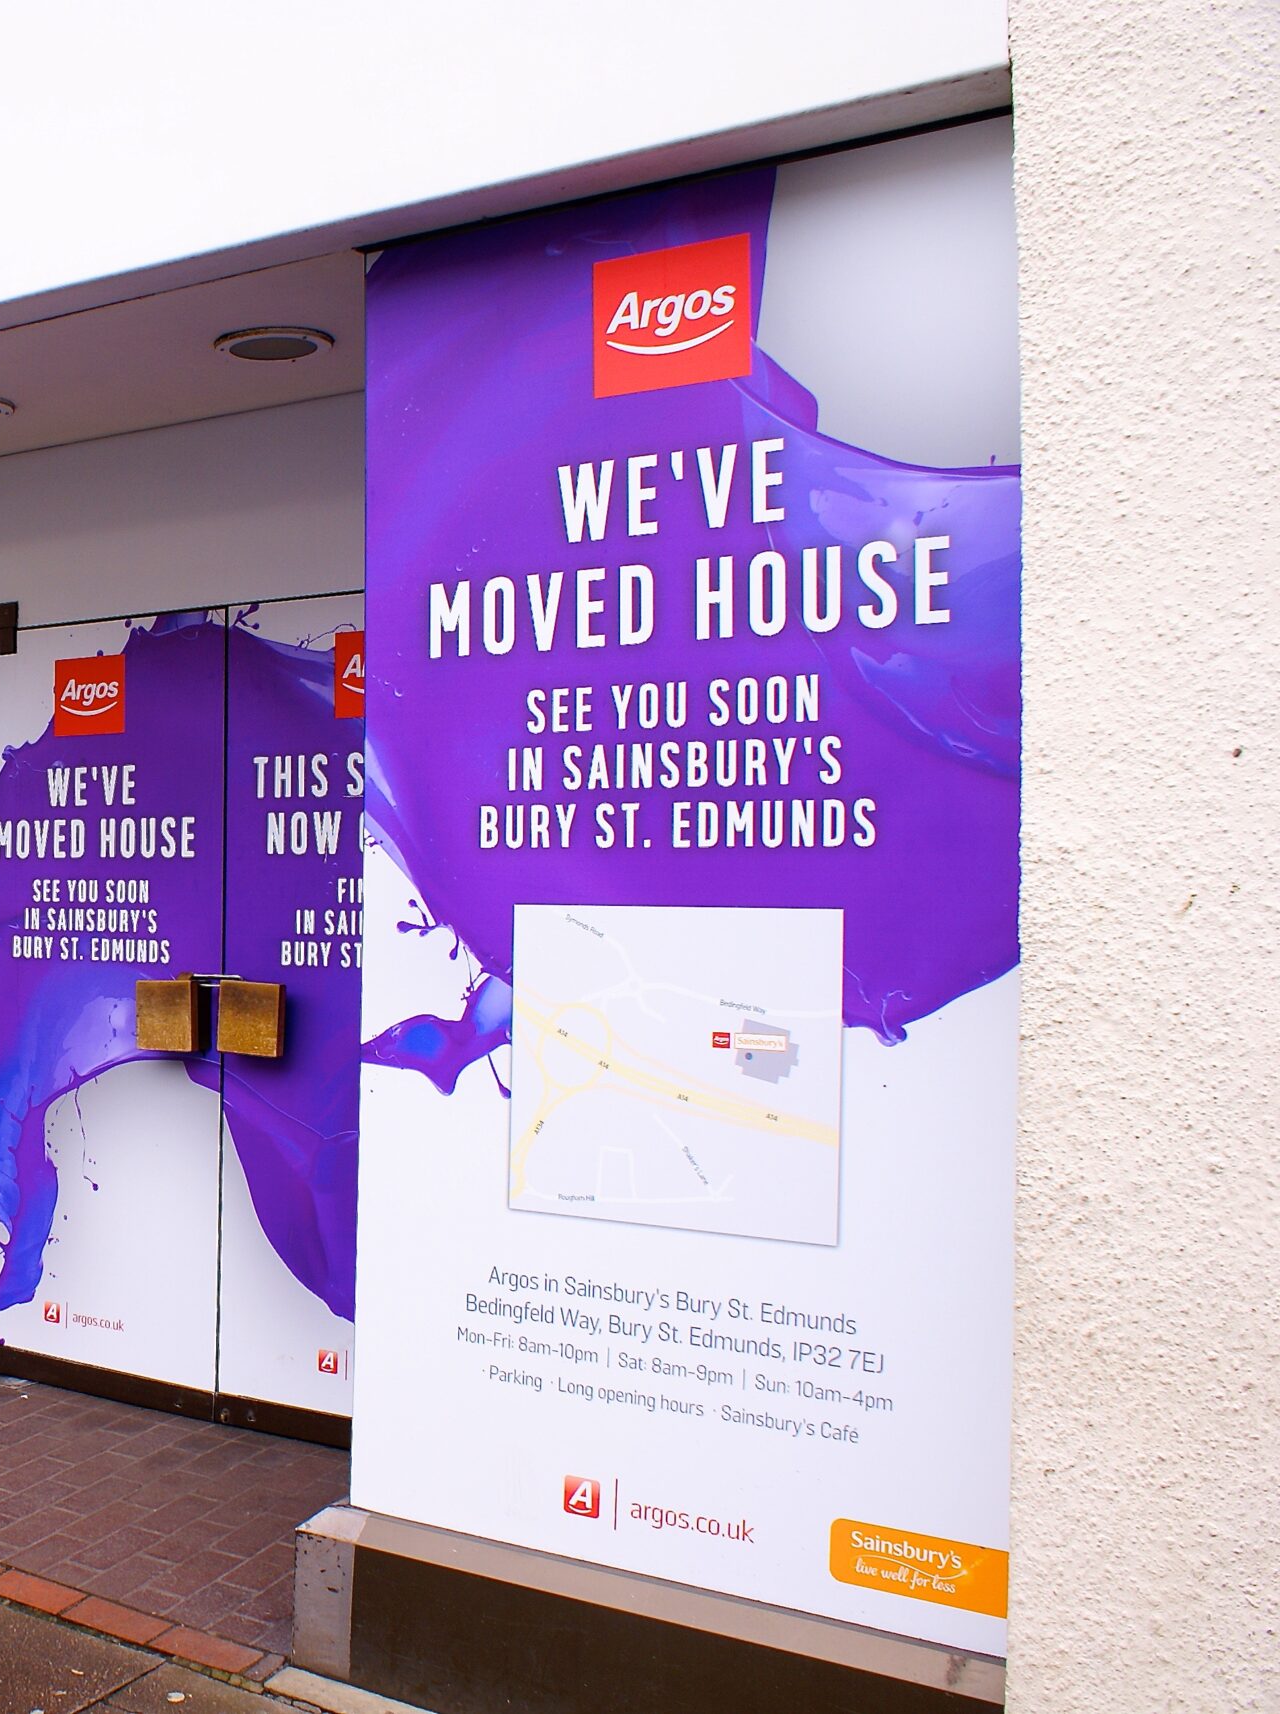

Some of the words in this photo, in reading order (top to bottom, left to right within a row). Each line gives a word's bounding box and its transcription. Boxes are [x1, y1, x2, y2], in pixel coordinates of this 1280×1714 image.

[607, 283, 736, 337] Argos
[556, 437, 785, 543] WE'VE
[429, 564, 654, 660] MOVED
[694, 534, 952, 642] HOUSE
[60, 678, 119, 706] Argos
[526, 686, 593, 734] SEE
[611, 680, 687, 731] YOU
[708, 673, 820, 728] SOON
[47, 764, 136, 807] WE'VE
[253, 754, 328, 799] THIS
[507, 747, 543, 792] IN
[562, 735, 843, 791] SAINSBURY'S
[100, 816, 195, 858] HOUSE
[266, 811, 342, 855] NOW
[479, 804, 576, 849] BURY
[594, 803, 652, 849] ST.
[672, 797, 877, 849] EDMUNDS
[32, 878, 60, 902] SEE
[67, 879, 99, 903] YOU
[105, 879, 149, 904] SOON
[24, 908, 40, 930] IN
[46, 907, 158, 934] SAINSBURY'S
[295, 909, 315, 935] IN
[12, 935, 53, 960] BURY
[60, 936, 84, 961] ST.
[90, 937, 170, 964] EDMUNDS
[280, 940, 331, 967] BURY
[72, 1311, 125, 1333] argos.co.uk
[488, 1265, 539, 1293] Argos
[544, 1272, 559, 1294] in
[564, 1276, 670, 1311] Sainsbury's
[676, 1291, 722, 1321] Bury
[727, 1297, 753, 1321] St.
[760, 1302, 857, 1336] Edmunds
[465, 1293, 554, 1325] Bedingfeld
[559, 1307, 603, 1337] Way,
[608, 1314, 653, 1344] Bury
[657, 1321, 683, 1345] St.
[689, 1325, 786, 1364] Edmunds,
[792, 1341, 842, 1369] IP32
[847, 1348, 885, 1375] 7EJ
[456, 1326, 515, 1350] Mon-Fri:
[517, 1335, 599, 1364] 8am-10pm
[618, 1351, 647, 1372] Sat:
[651, 1357, 733, 1388] 8am-9pm
[754, 1373, 790, 1395] Sun:
[795, 1379, 894, 1413] 10am-4pm
[489, 1364, 543, 1393] Parking
[557, 1375, 594, 1402] Long
[597, 1384, 656, 1412] opening
[660, 1392, 705, 1418] hours
[720, 1404, 816, 1439] Sainsbury's
[820, 1421, 859, 1445] Café
[630, 1499, 755, 1545] argos.co.uk
[850, 1528, 962, 1571] Sainsbury's
[879, 1565, 910, 1585] well
